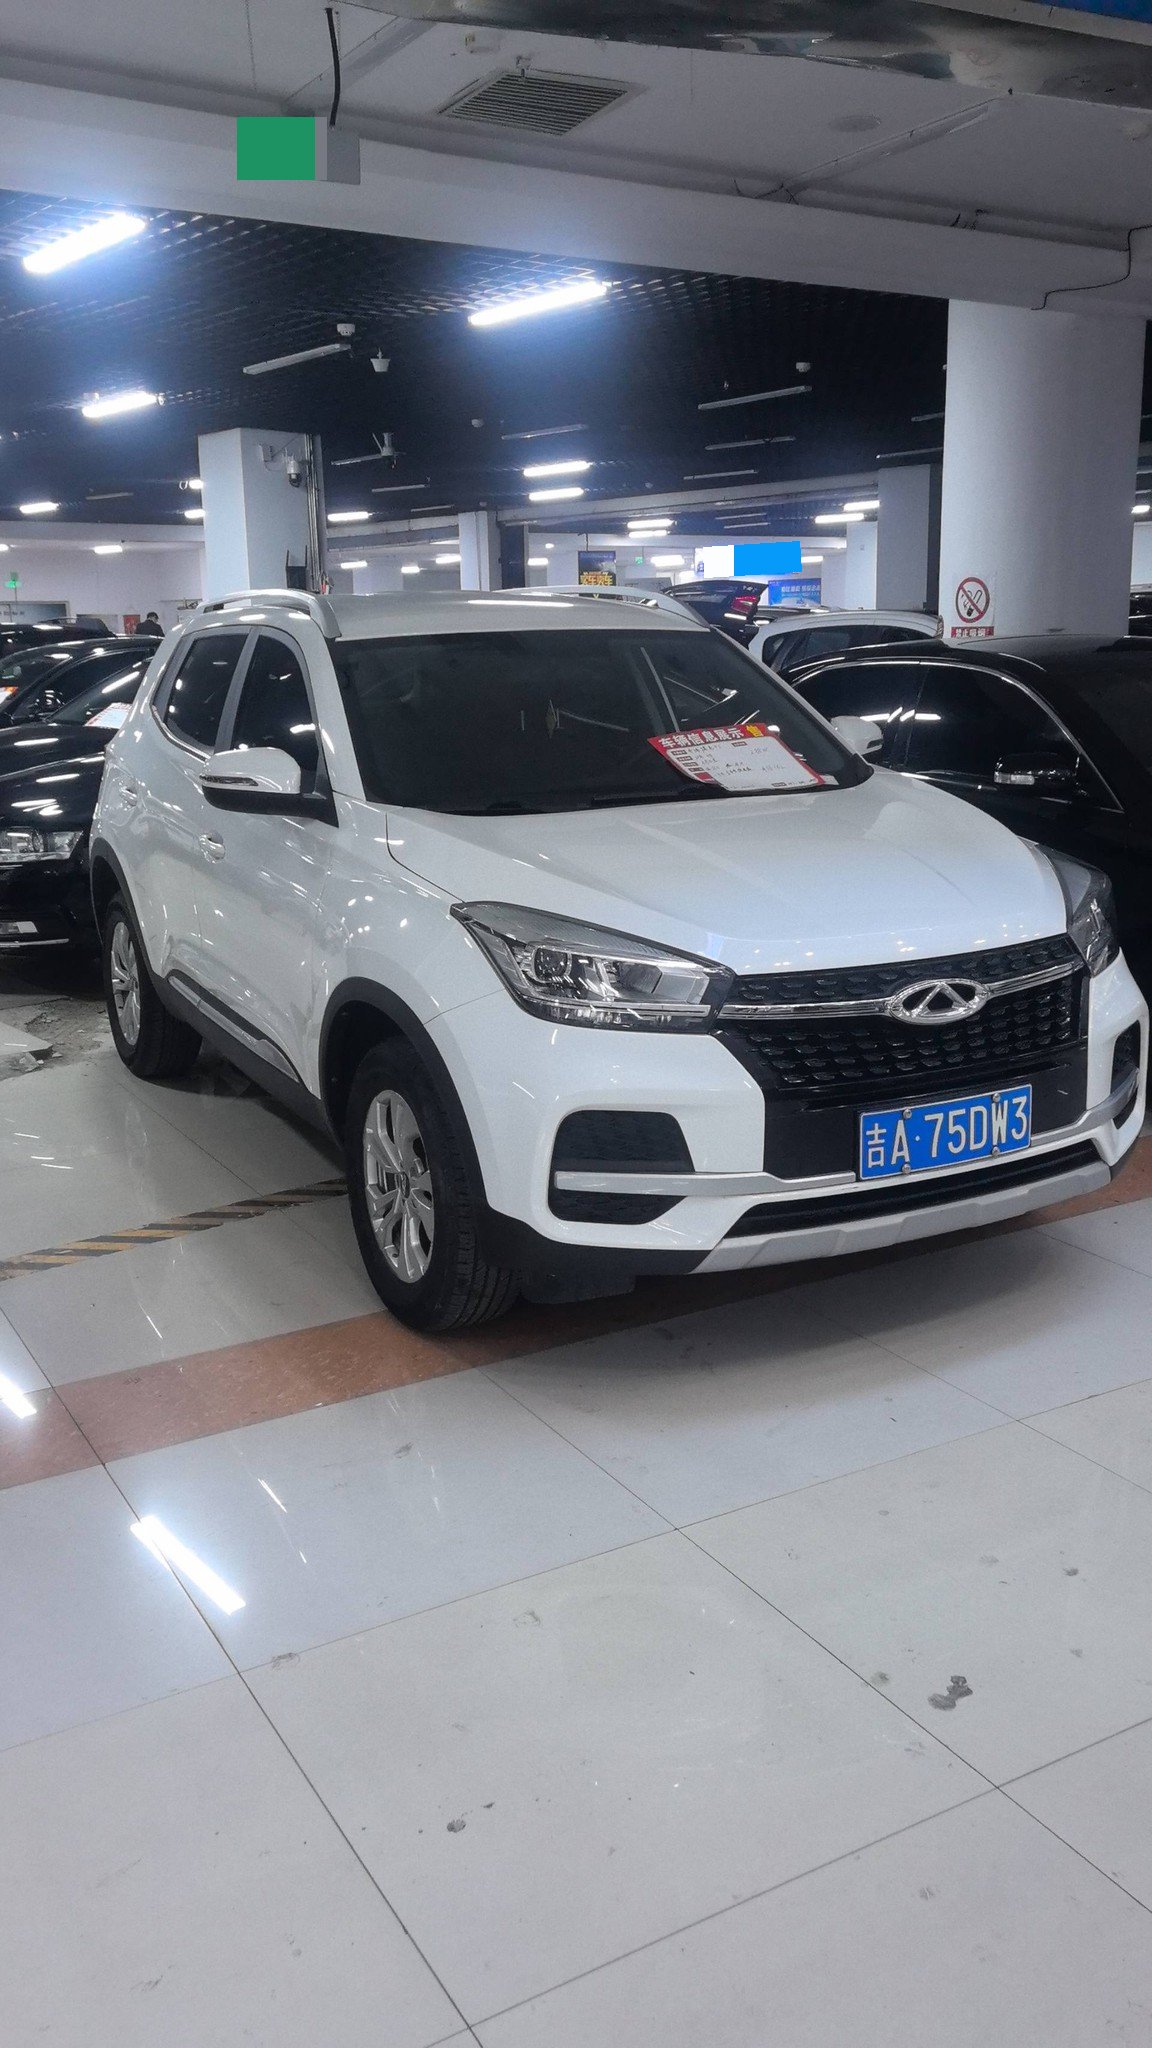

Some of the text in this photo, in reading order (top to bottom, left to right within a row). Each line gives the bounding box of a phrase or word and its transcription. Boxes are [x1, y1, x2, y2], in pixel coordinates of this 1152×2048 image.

[659, 728, 744, 748] 车辆信息展示
[866, 1095, 1028, 1168] 吉A·75DW3
